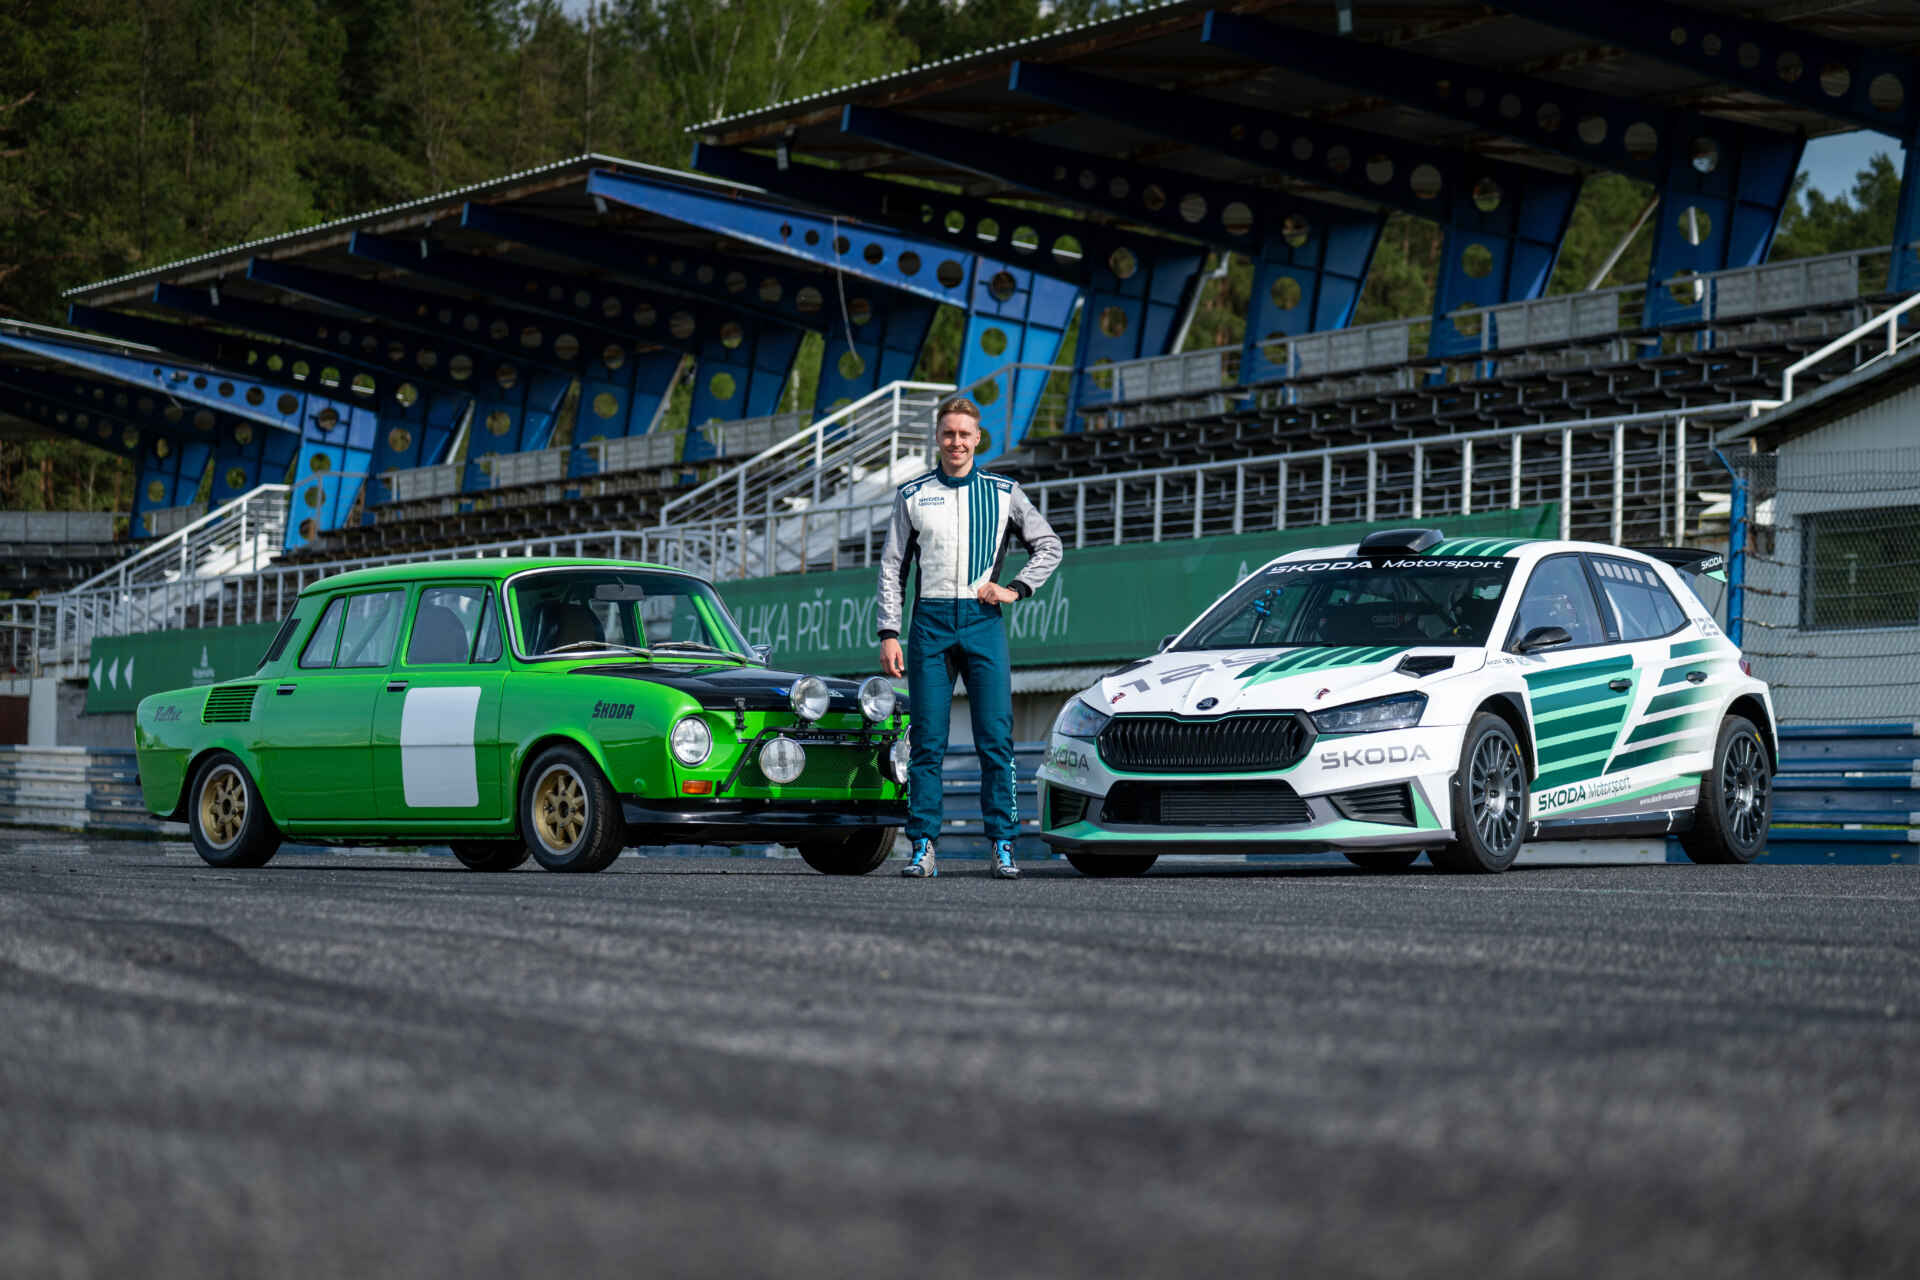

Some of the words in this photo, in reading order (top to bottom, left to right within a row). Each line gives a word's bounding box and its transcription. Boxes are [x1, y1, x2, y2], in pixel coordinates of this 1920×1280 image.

[1266, 560, 1373, 575] SKODA
[1382, 559, 1505, 570] Motorsport
[1701, 556, 1723, 570] SKODA
[796, 587, 832, 653] PŘI
[1010, 572, 1070, 642] km/h
[1692, 617, 1720, 637] 125
[153, 705, 183, 723] Rallye
[592, 699, 635, 720] ŠKODA
[1320, 744, 1432, 770] SKODA
[1538, 785, 1586, 812] SKODA
[1588, 776, 1632, 799] Motorsport
